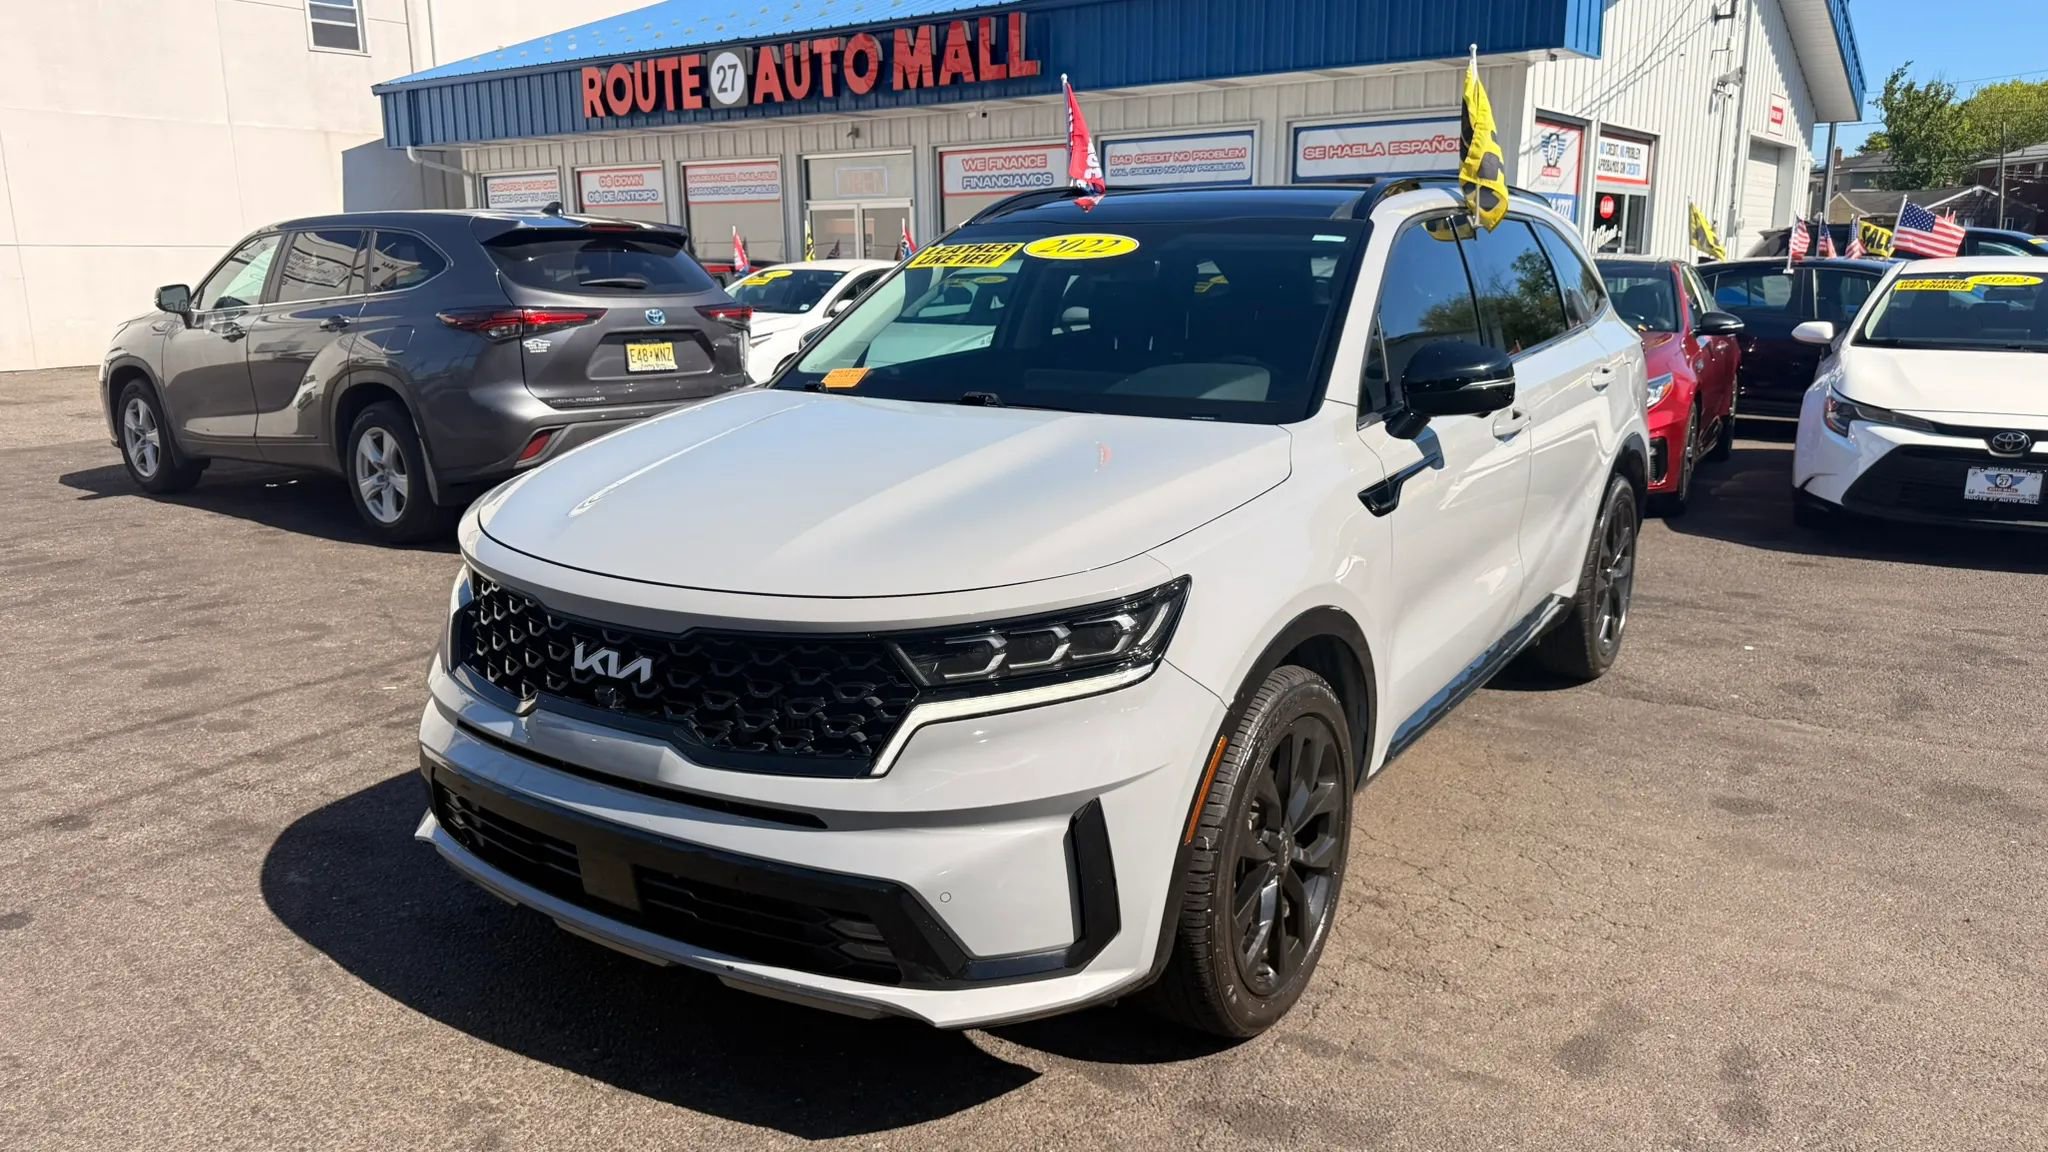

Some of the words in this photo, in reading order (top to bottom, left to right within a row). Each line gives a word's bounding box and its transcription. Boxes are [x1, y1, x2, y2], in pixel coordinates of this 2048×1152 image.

[581, 54, 702, 119] ROUTE
[716, 63, 738, 94] 27
[753, 32, 879, 105] AUTO
[892, 12, 1039, 91] MALL
[1110, 155, 1133, 165] BAD
[1134, 152, 1172, 164] CREDIT
[1173, 151, 1191, 163] NO
[1192, 147, 1247, 161] PROBLEM
[1303, 146, 1327, 161] SE
[1328, 142, 1384, 159] HABLA
[962, 158, 986, 172] WE
[988, 154, 1047, 171] FINANCE
[1110, 168, 1129, 177] MAL
[1197, 162, 1246, 173] PROBLEMA
[599, 174, 613, 188] 0$
[614, 174, 644, 187] DOWN
[962, 172, 1054, 190] FINANCIAMOS
[588, 189, 602, 203] 0$
[602, 190, 616, 202] DE
[617, 188, 659, 201] ANTICIPO
[925, 243, 1020, 256] LEATHER
[1038, 239, 1121, 254] 2022
[916, 254, 958, 265] LIKE
[953, 253, 1004, 265] NEW
[1979, 275, 2030, 283] 2023
[629, 348, 649, 363] E48
[1999, 478, 2009, 486] 27
[572, 642, 654, 684] KIA
